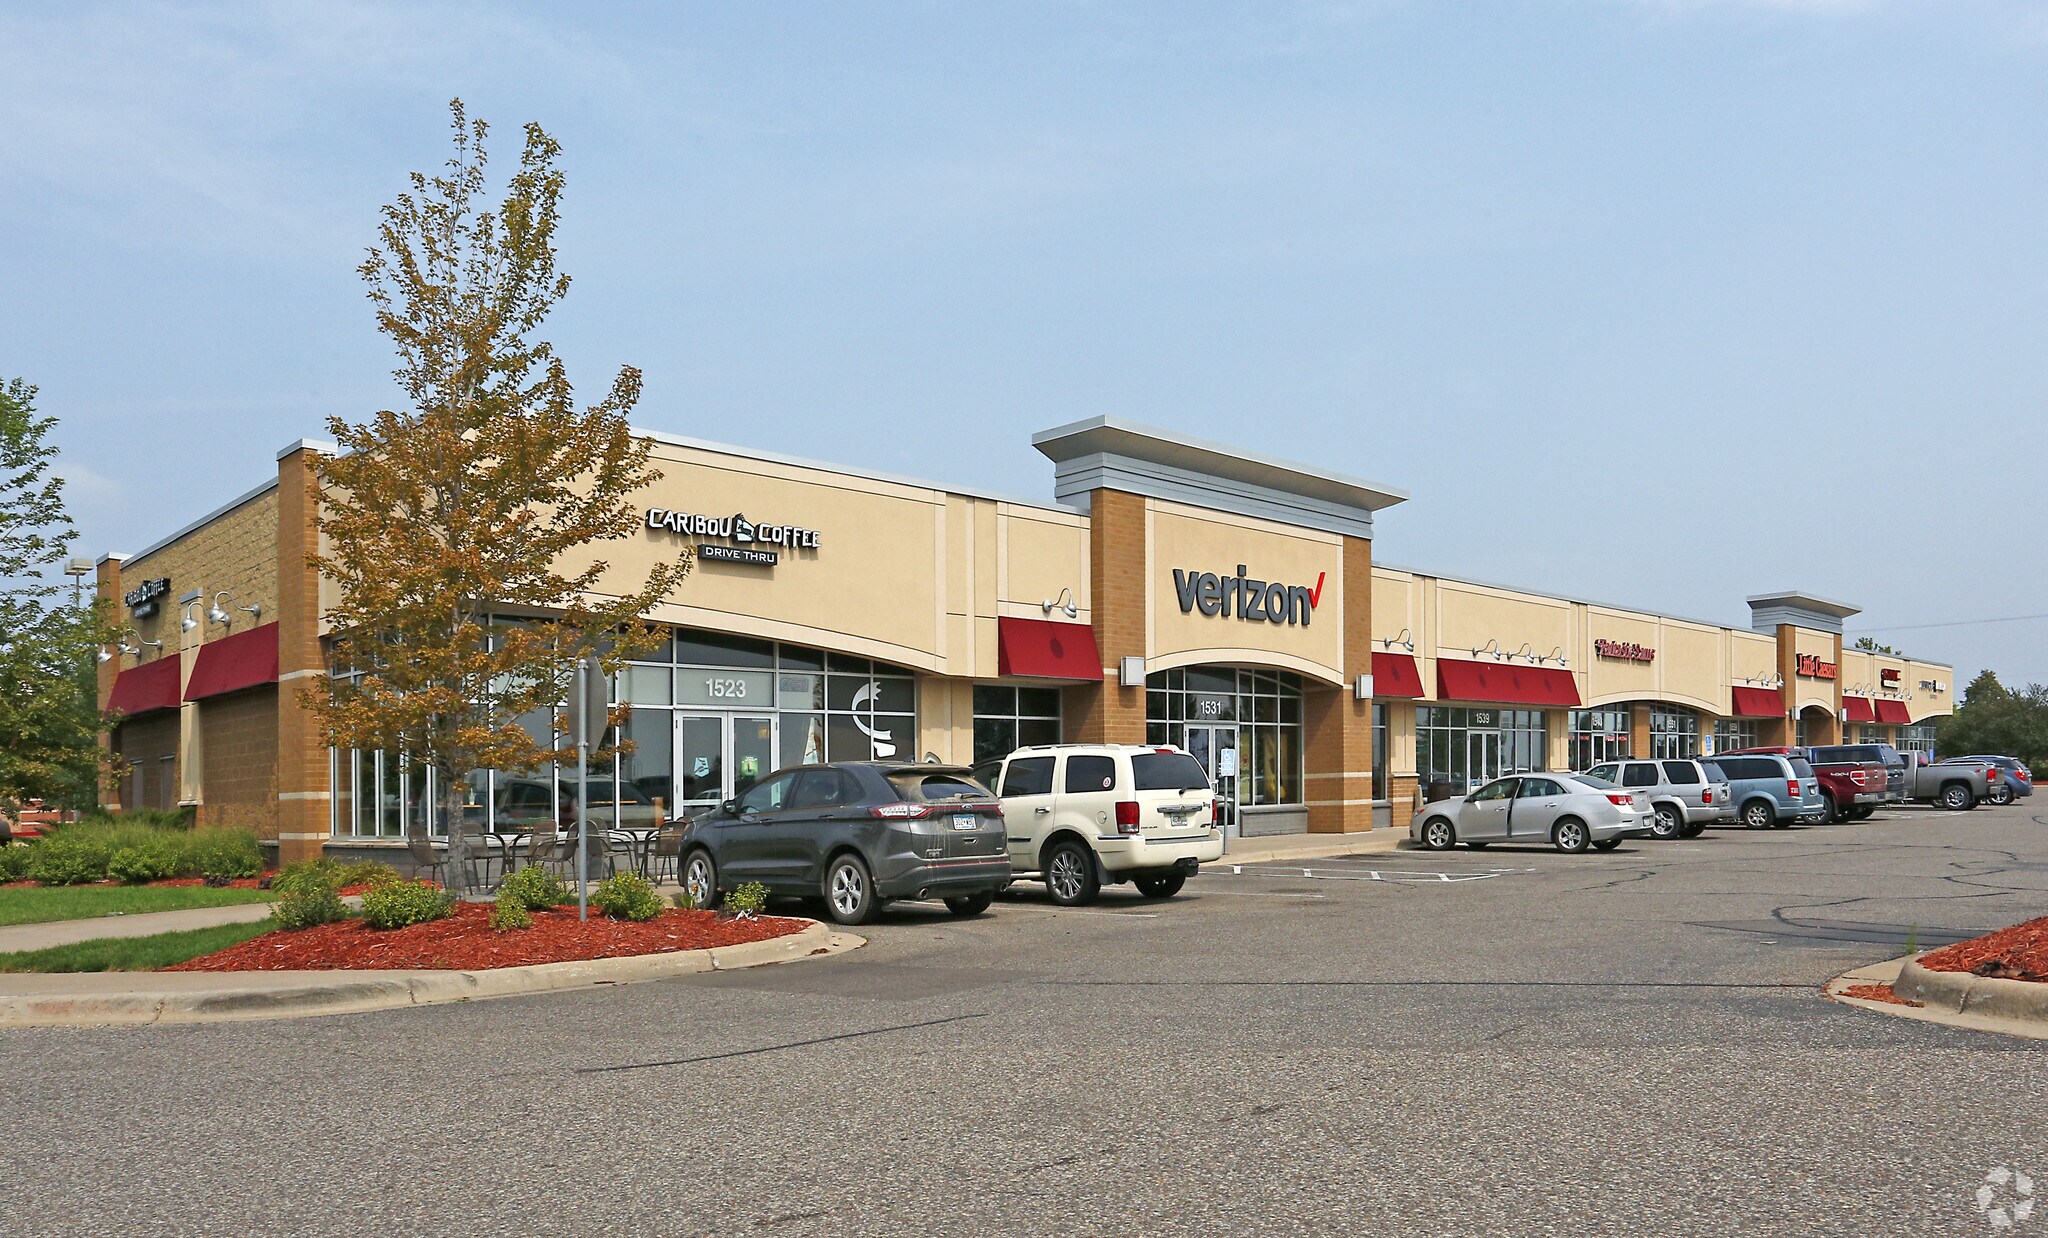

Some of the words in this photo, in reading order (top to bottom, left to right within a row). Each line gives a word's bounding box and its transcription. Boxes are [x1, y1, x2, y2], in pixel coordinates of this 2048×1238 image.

[646, 508, 732, 537] CARIBOU
[757, 523, 822, 548] COFFEE
[705, 547, 740, 559] DRIVE
[744, 551, 775, 563] THRU
[1172, 564, 1310, 626] verizon
[1797, 653, 1815, 676] Little
[1814, 656, 1837, 679] Caesars
[706, 679, 746, 698] 1523
[1200, 701, 1221, 714] 1531
[1475, 713, 1490, 724] 1539
